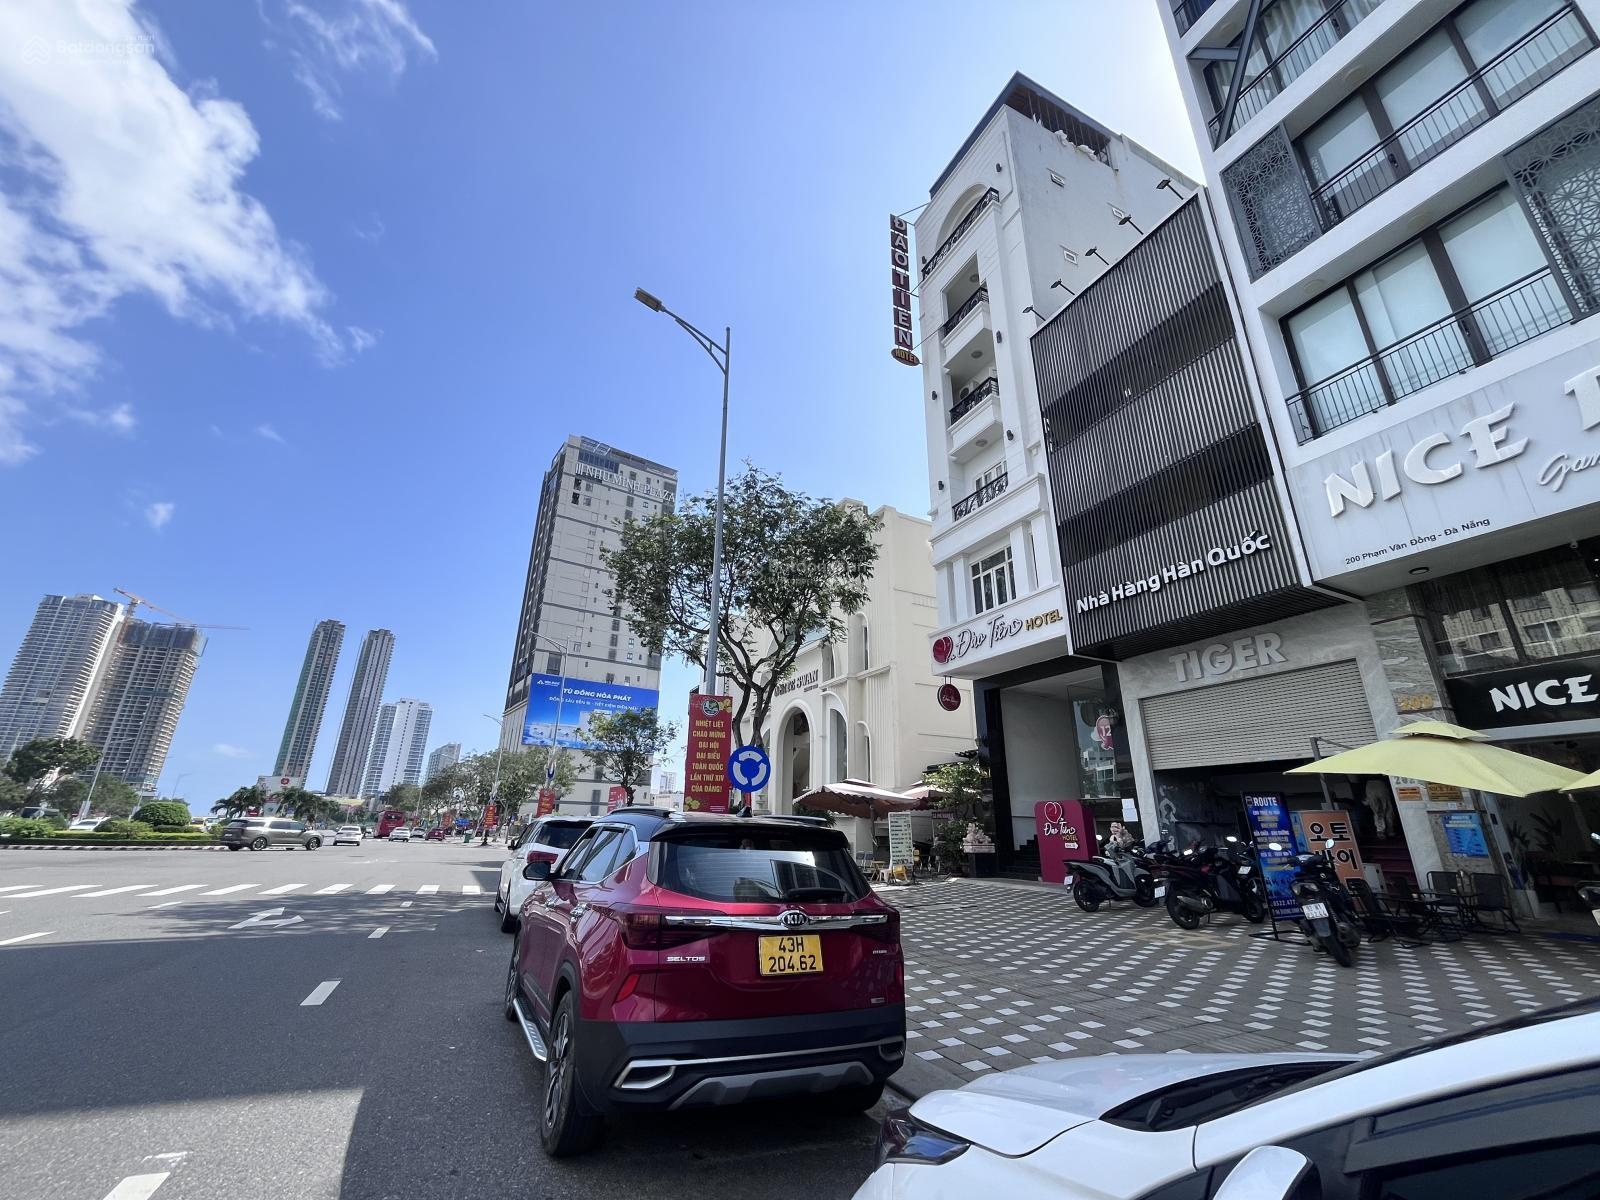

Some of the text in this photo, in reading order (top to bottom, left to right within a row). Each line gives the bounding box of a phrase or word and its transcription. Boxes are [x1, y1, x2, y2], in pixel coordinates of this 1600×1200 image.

[1324, 401, 1530, 518] NICE
[612, 474, 641, 493] MINH
[643, 484, 675, 502] PLAZA
[1345, 555, 1361, 565] 200
[1362, 548, 1387, 560] Phạm
[1410, 533, 1437, 546] Đồng
[1444, 527, 1459, 536] Đà
[1076, 530, 1271, 614] Nhà Hàng Hàn Quốc
[1026, 609, 1064, 631] HOTEL
[1168, 632, 1288, 682] TIGER
[612, 694, 632, 702] PHÁT
[1489, 674, 1600, 712] NICE
[1252, 796, 1278, 807] ROUTE
[1309, 822, 1352, 842] 오토
[787, 914, 805, 924] KIA
[779, 936, 805, 953] 43H
[768, 954, 817, 973] 204.62
